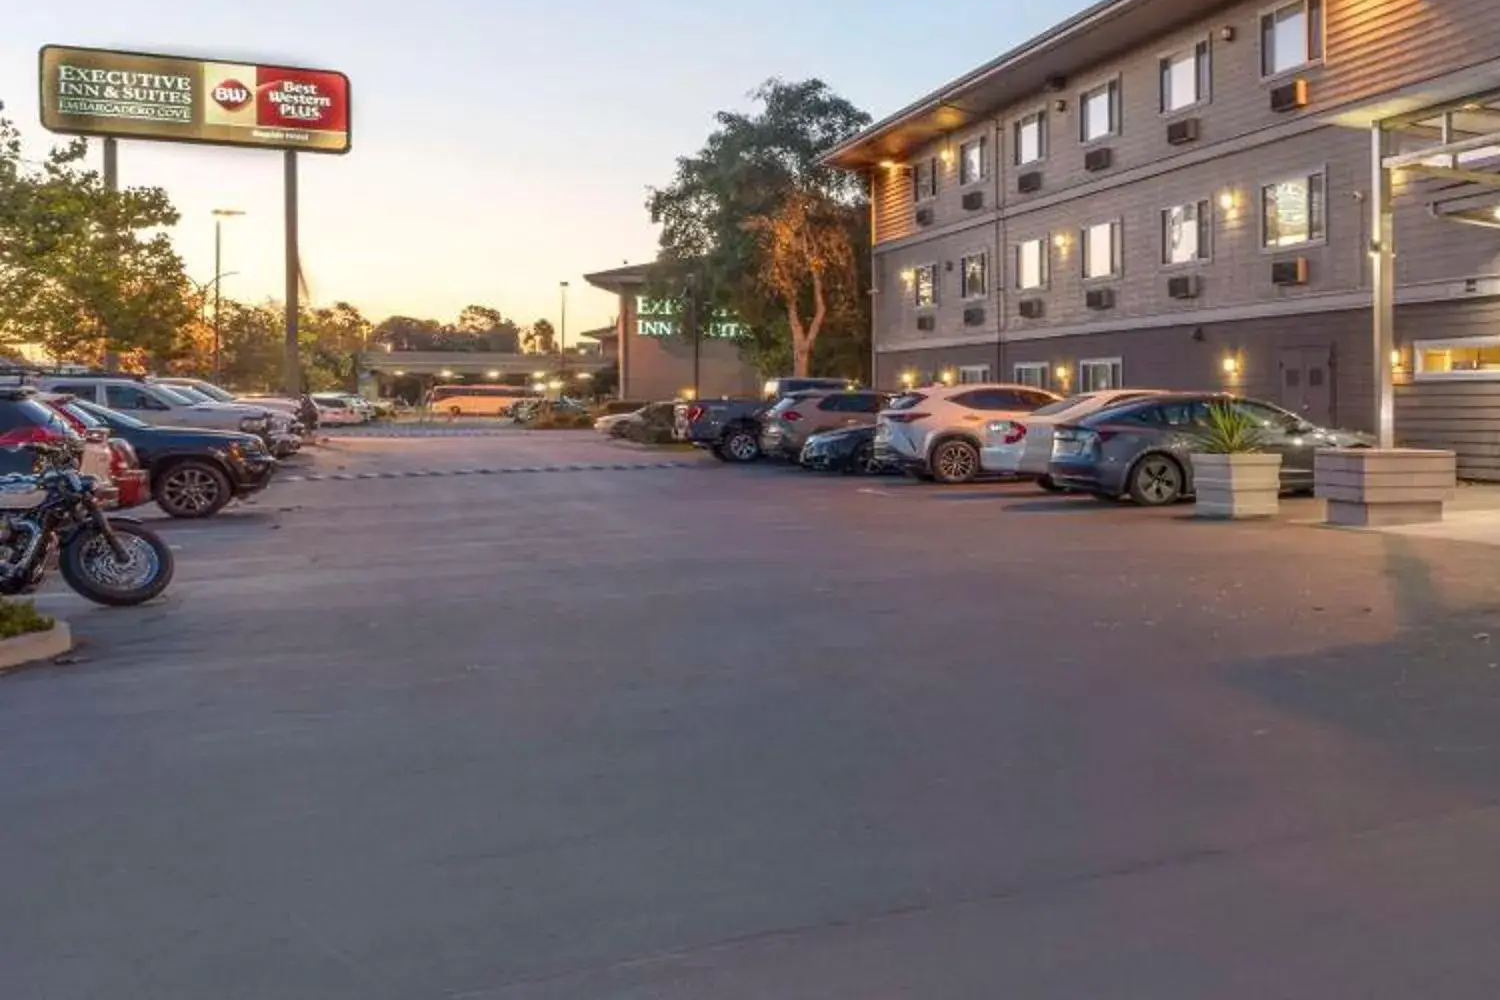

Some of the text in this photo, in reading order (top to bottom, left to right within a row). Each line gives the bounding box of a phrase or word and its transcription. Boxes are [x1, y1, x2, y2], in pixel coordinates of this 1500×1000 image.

[58, 65, 192, 91] EXECUTIVE
[58, 82, 193, 105] INN & SUITES
[215, 87, 248, 102] BW
[283, 81, 318, 95] Best
[268, 91, 332, 107] Western
[636, 319, 673, 336] INN
